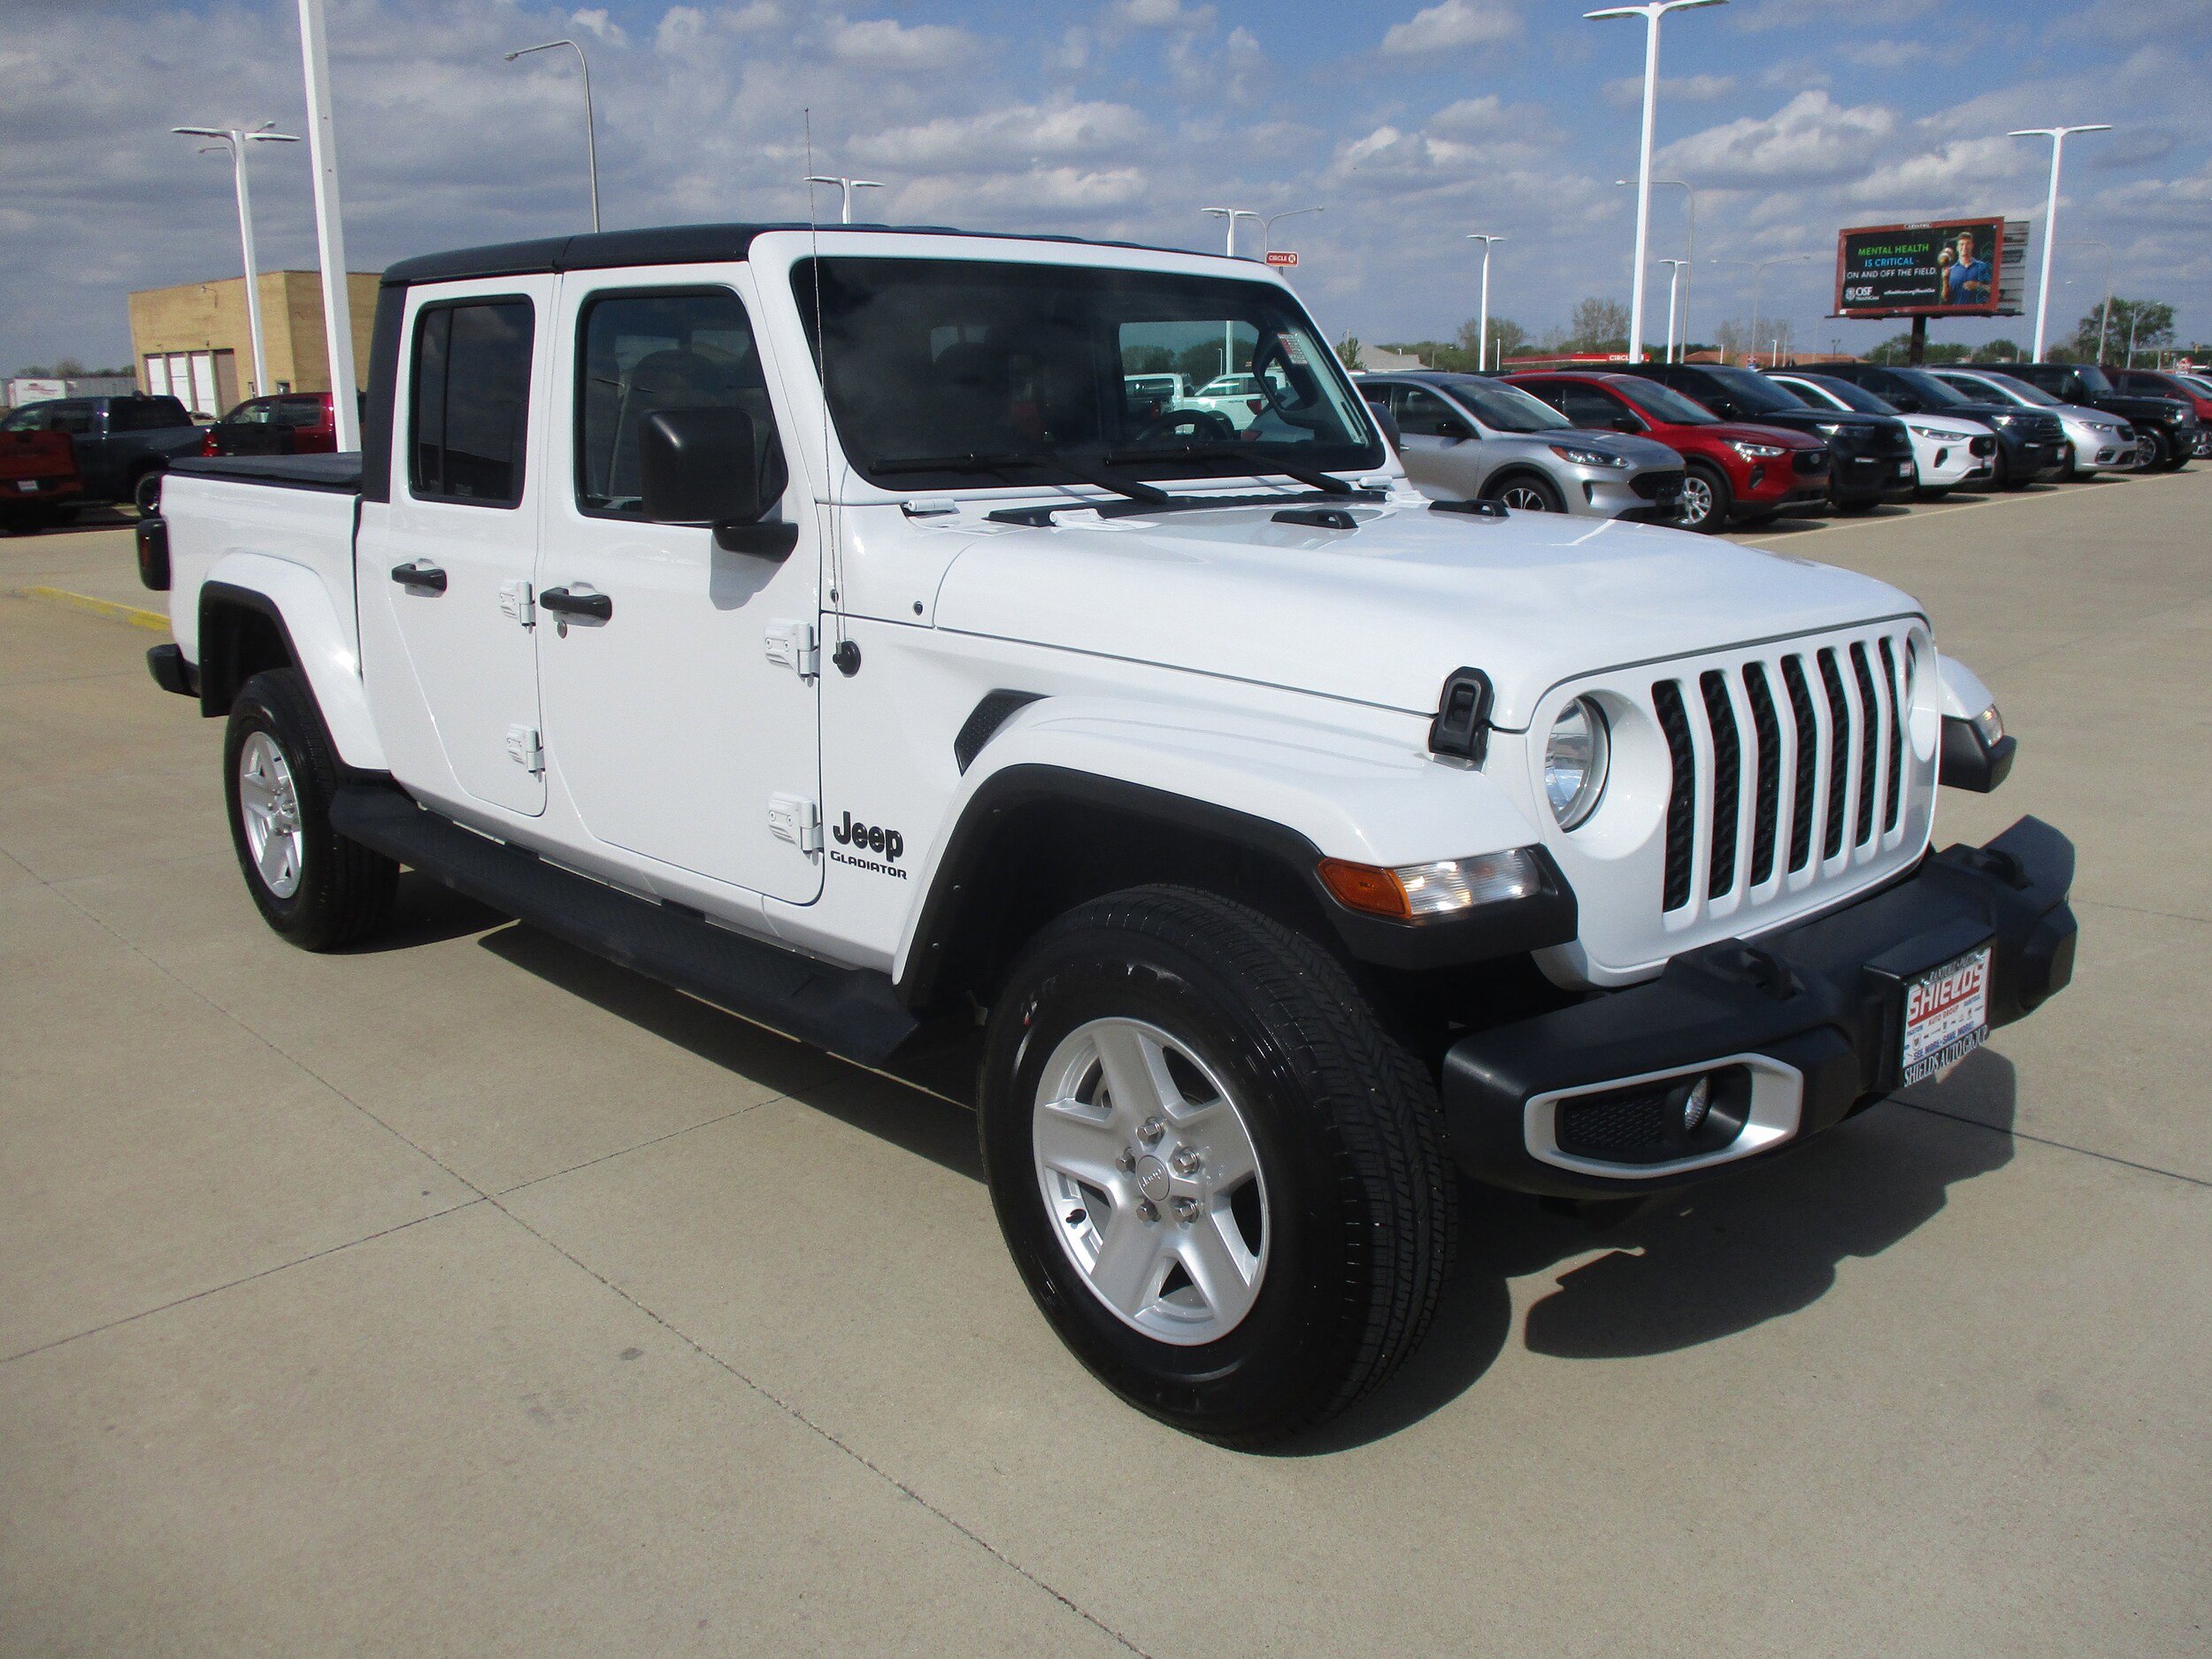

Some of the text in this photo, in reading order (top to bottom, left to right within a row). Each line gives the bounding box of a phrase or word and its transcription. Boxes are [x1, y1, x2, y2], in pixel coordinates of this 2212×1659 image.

[1858, 243, 1929, 256] MENTAL HEALTH
[1875, 257, 1914, 266] CRITICAL
[1855, 287, 1873, 296] OSF
[833, 810, 903, 863] Jeep
[831, 849, 907, 879] GLADIATOR
[1908, 960, 1984, 1019] SHIELDS
[1904, 1025, 1987, 1087] SHIELDS AUTO GROUP
[1913, 1048, 1924, 1060] SEE
